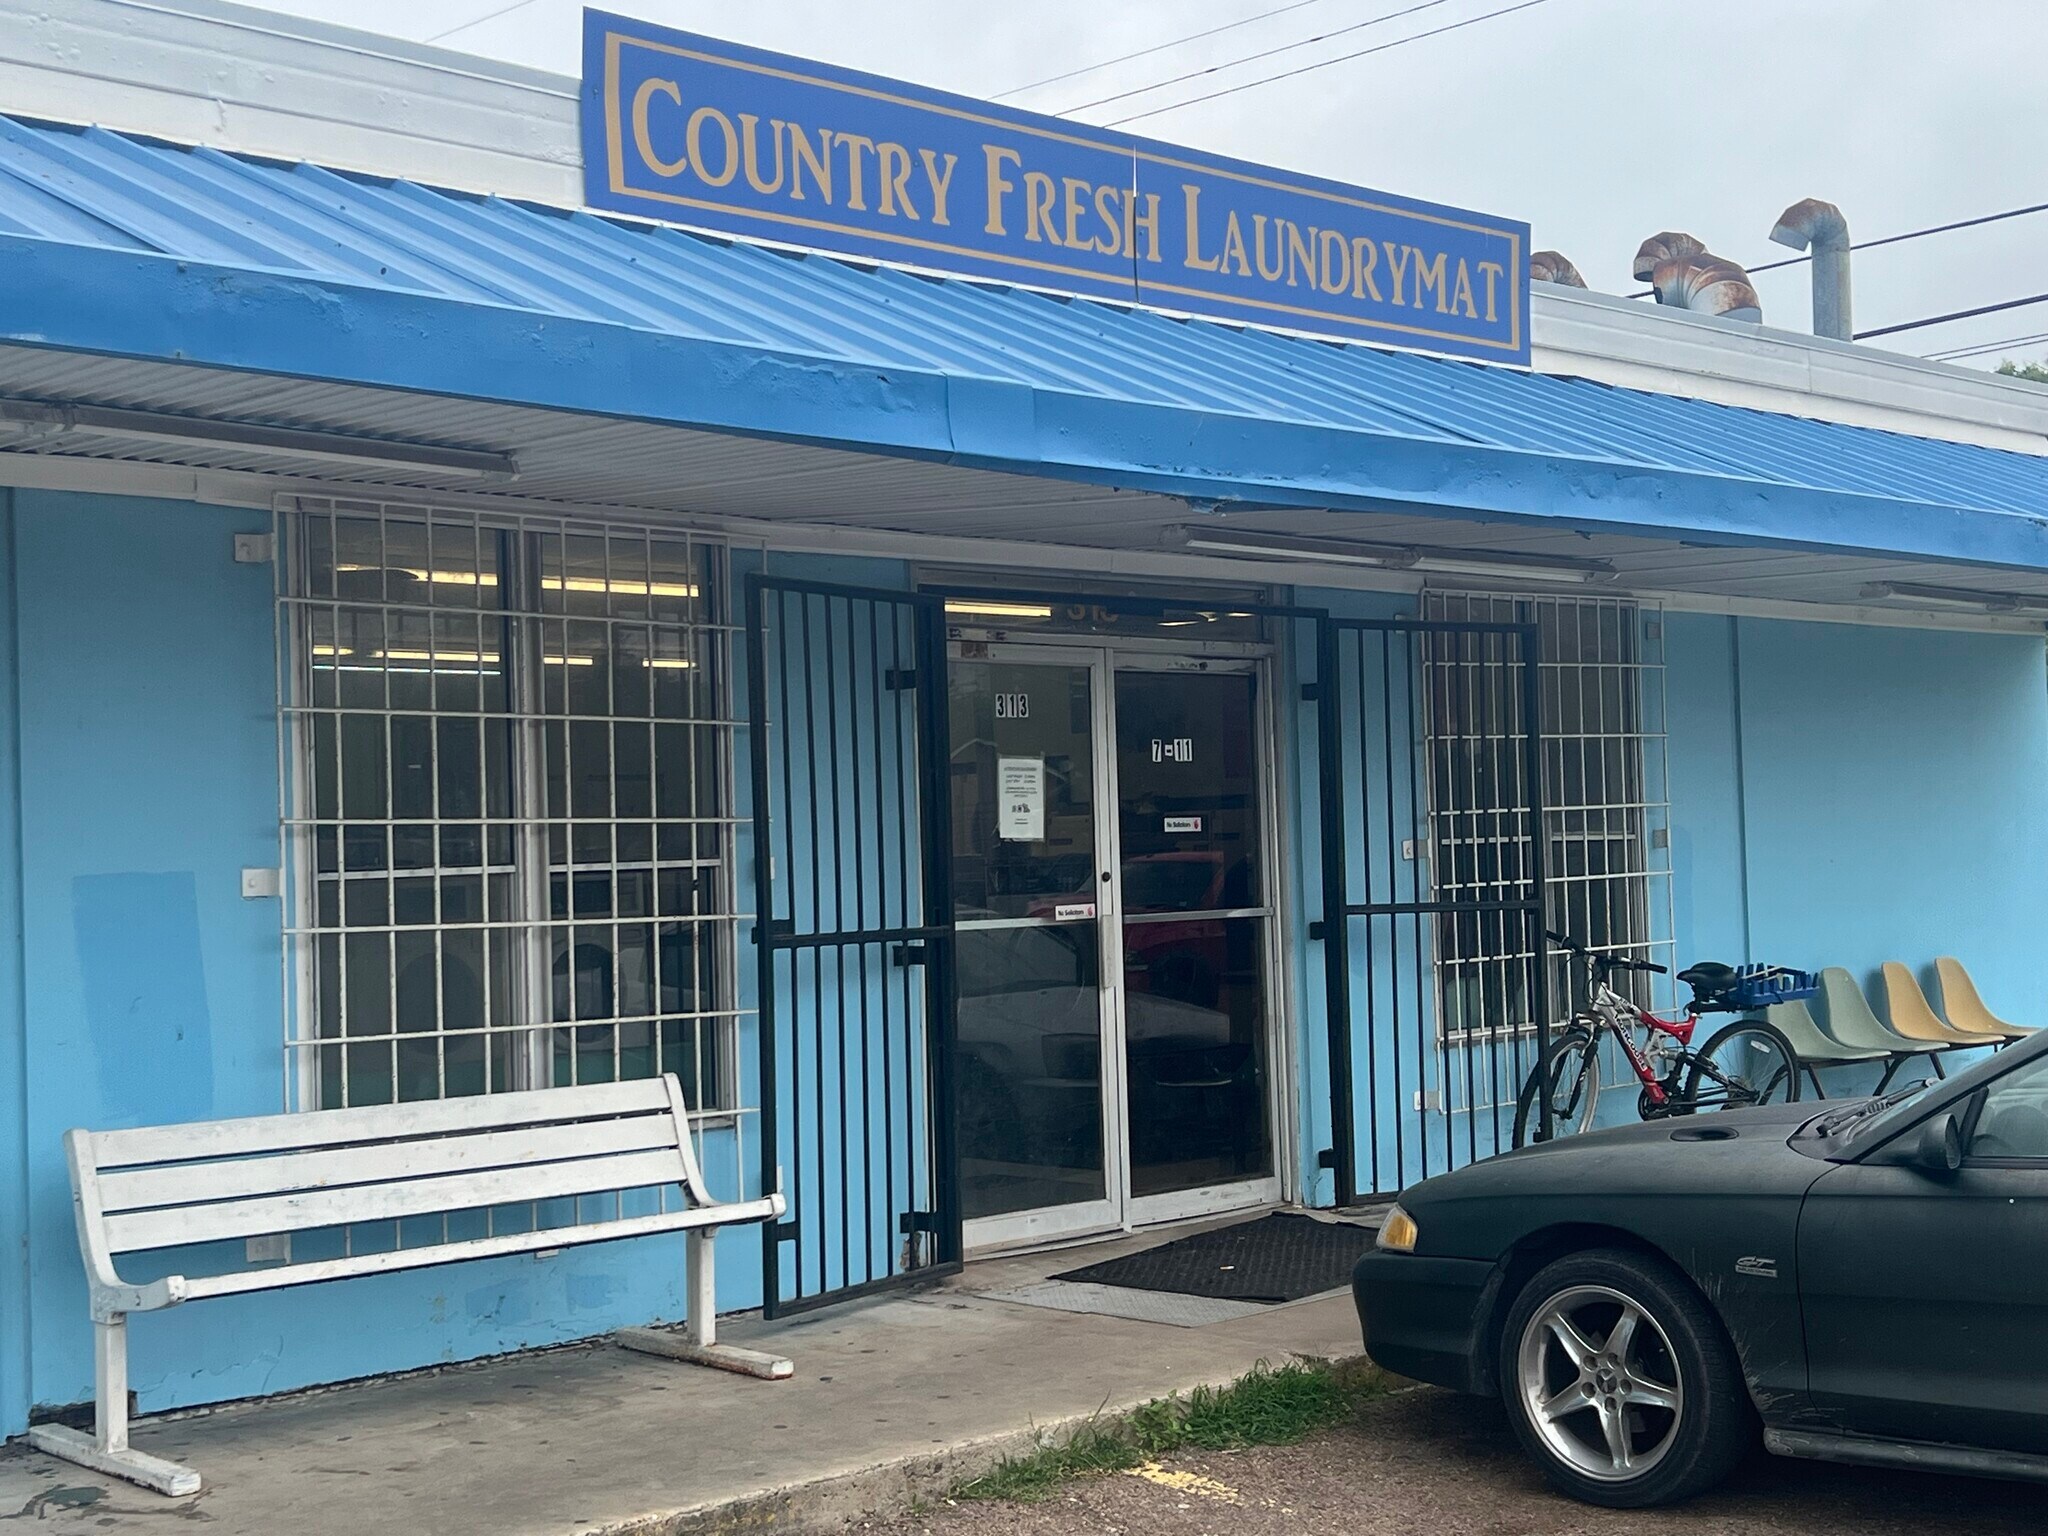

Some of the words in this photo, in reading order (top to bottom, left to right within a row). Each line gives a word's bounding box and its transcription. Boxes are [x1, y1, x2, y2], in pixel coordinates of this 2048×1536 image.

[631, 76, 959, 228] COUNTRY
[984, 144, 1162, 264] FRESH
[1181, 183, 1505, 324] LAUNDRYMAT
[996, 694, 1028, 717] 313
[1153, 739, 1191, 761] 7-11
